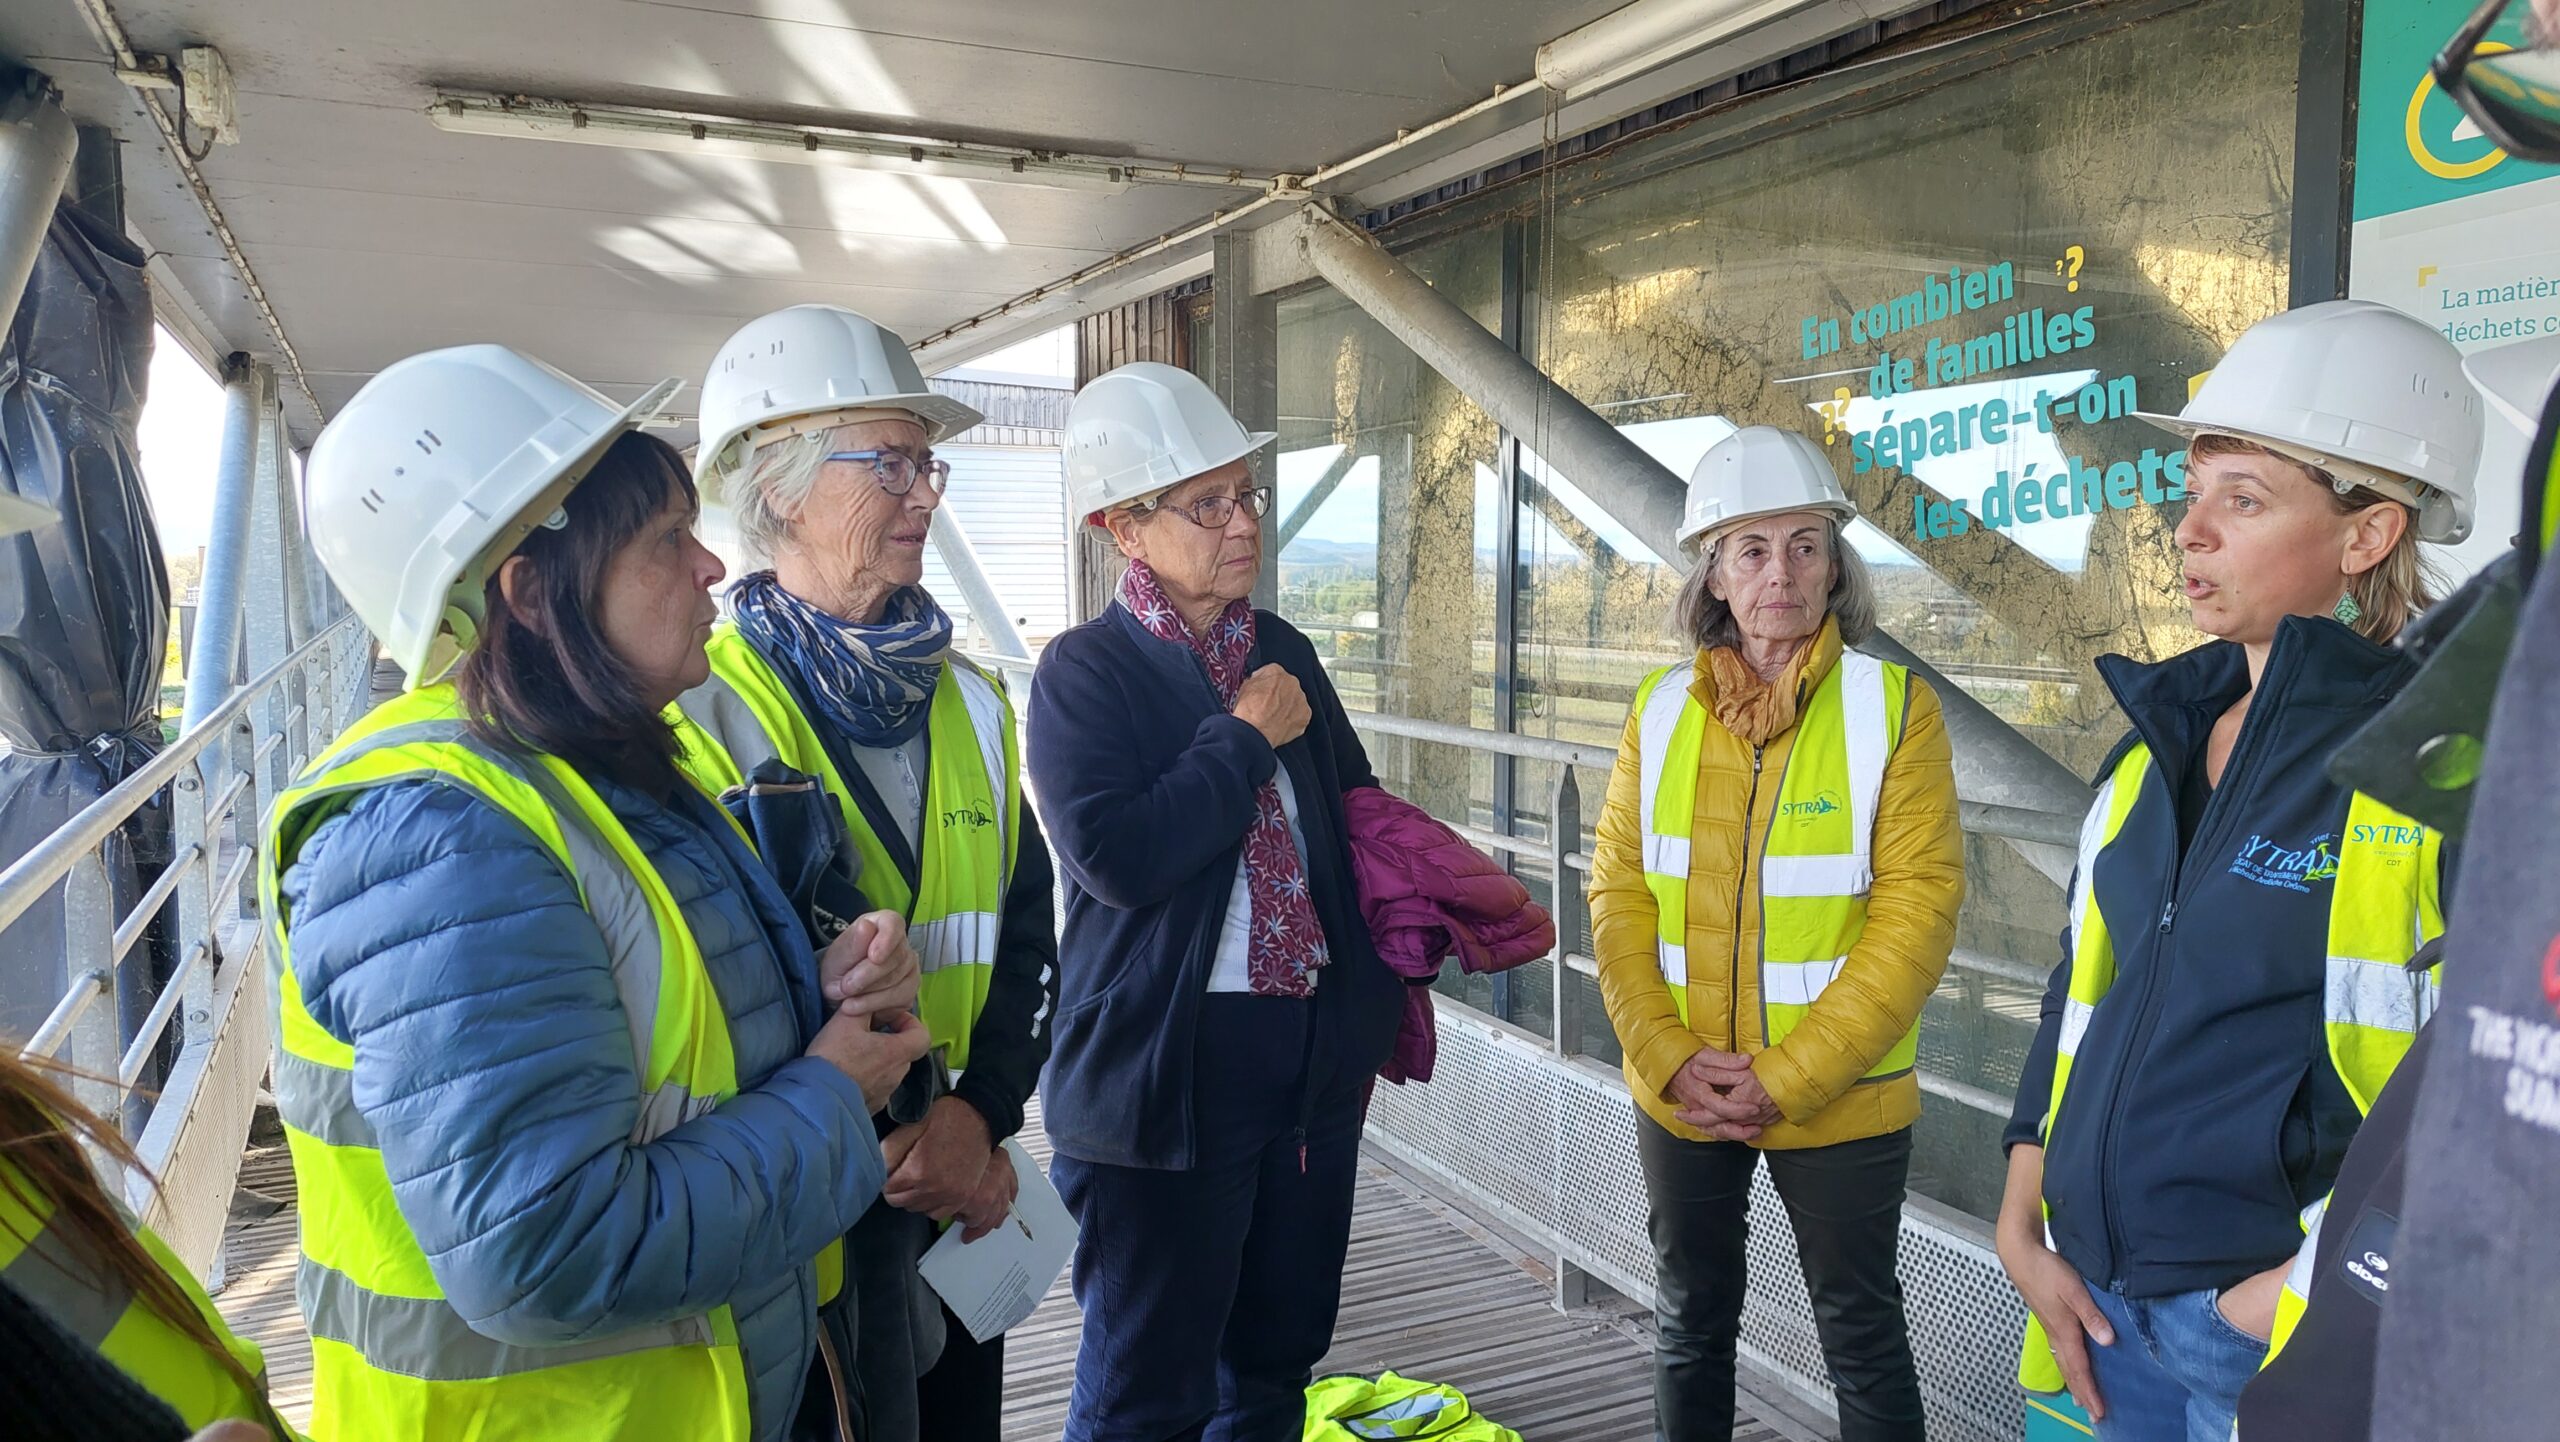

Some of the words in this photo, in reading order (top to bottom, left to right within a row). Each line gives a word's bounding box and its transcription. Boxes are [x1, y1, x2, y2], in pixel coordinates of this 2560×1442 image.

[1801, 314, 1840, 360] En
[1850, 261, 2014, 345] combien
[2441, 289, 2469, 310] La
[2476, 276, 2560, 305] matièr
[2442, 317, 2536, 343] déchets
[1869, 352, 1914, 400] de
[1925, 305, 2096, 385] familles
[1852, 374, 2138, 476] sépare-t-on
[1914, 495, 1969, 541] les
[1981, 447, 2187, 530] déchets
[2351, 824, 2424, 847] SYTRA
